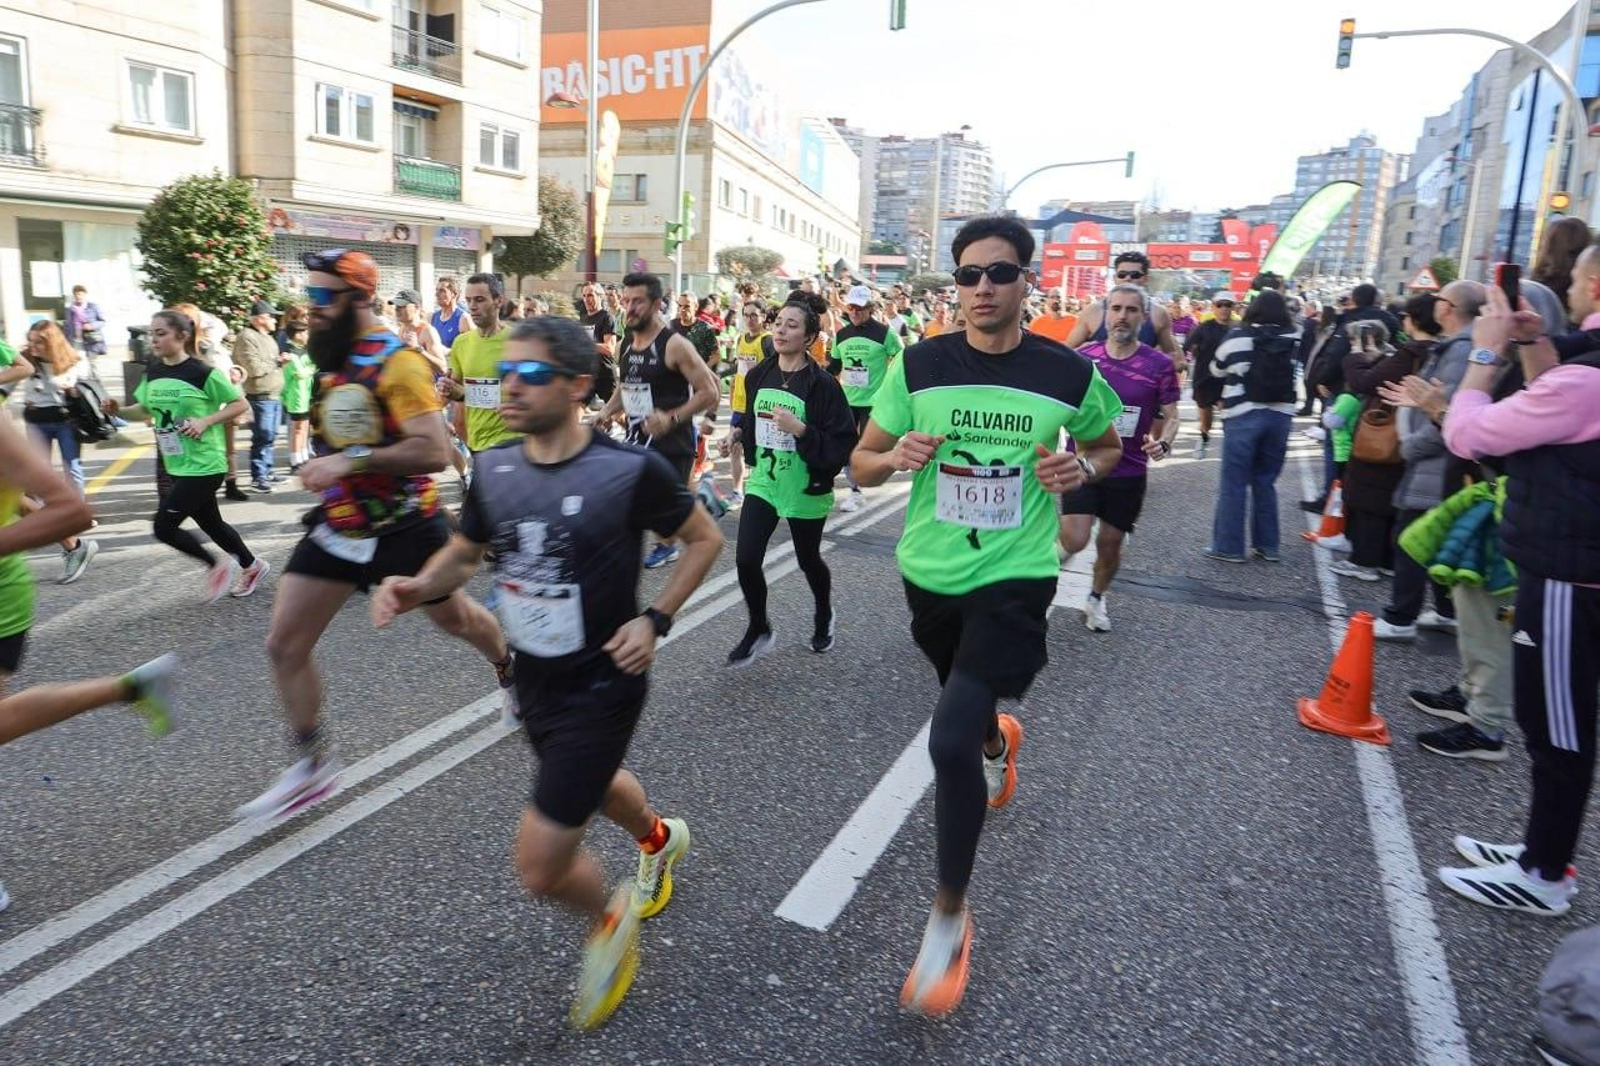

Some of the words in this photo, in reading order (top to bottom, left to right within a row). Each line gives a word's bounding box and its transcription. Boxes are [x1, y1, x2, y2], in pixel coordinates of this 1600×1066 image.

[541, 44, 706, 101] BASIC-FIT
[951, 409, 1033, 433] CALVARIO
[964, 432, 1034, 450] Santander
[955, 483, 1005, 505] 1618
